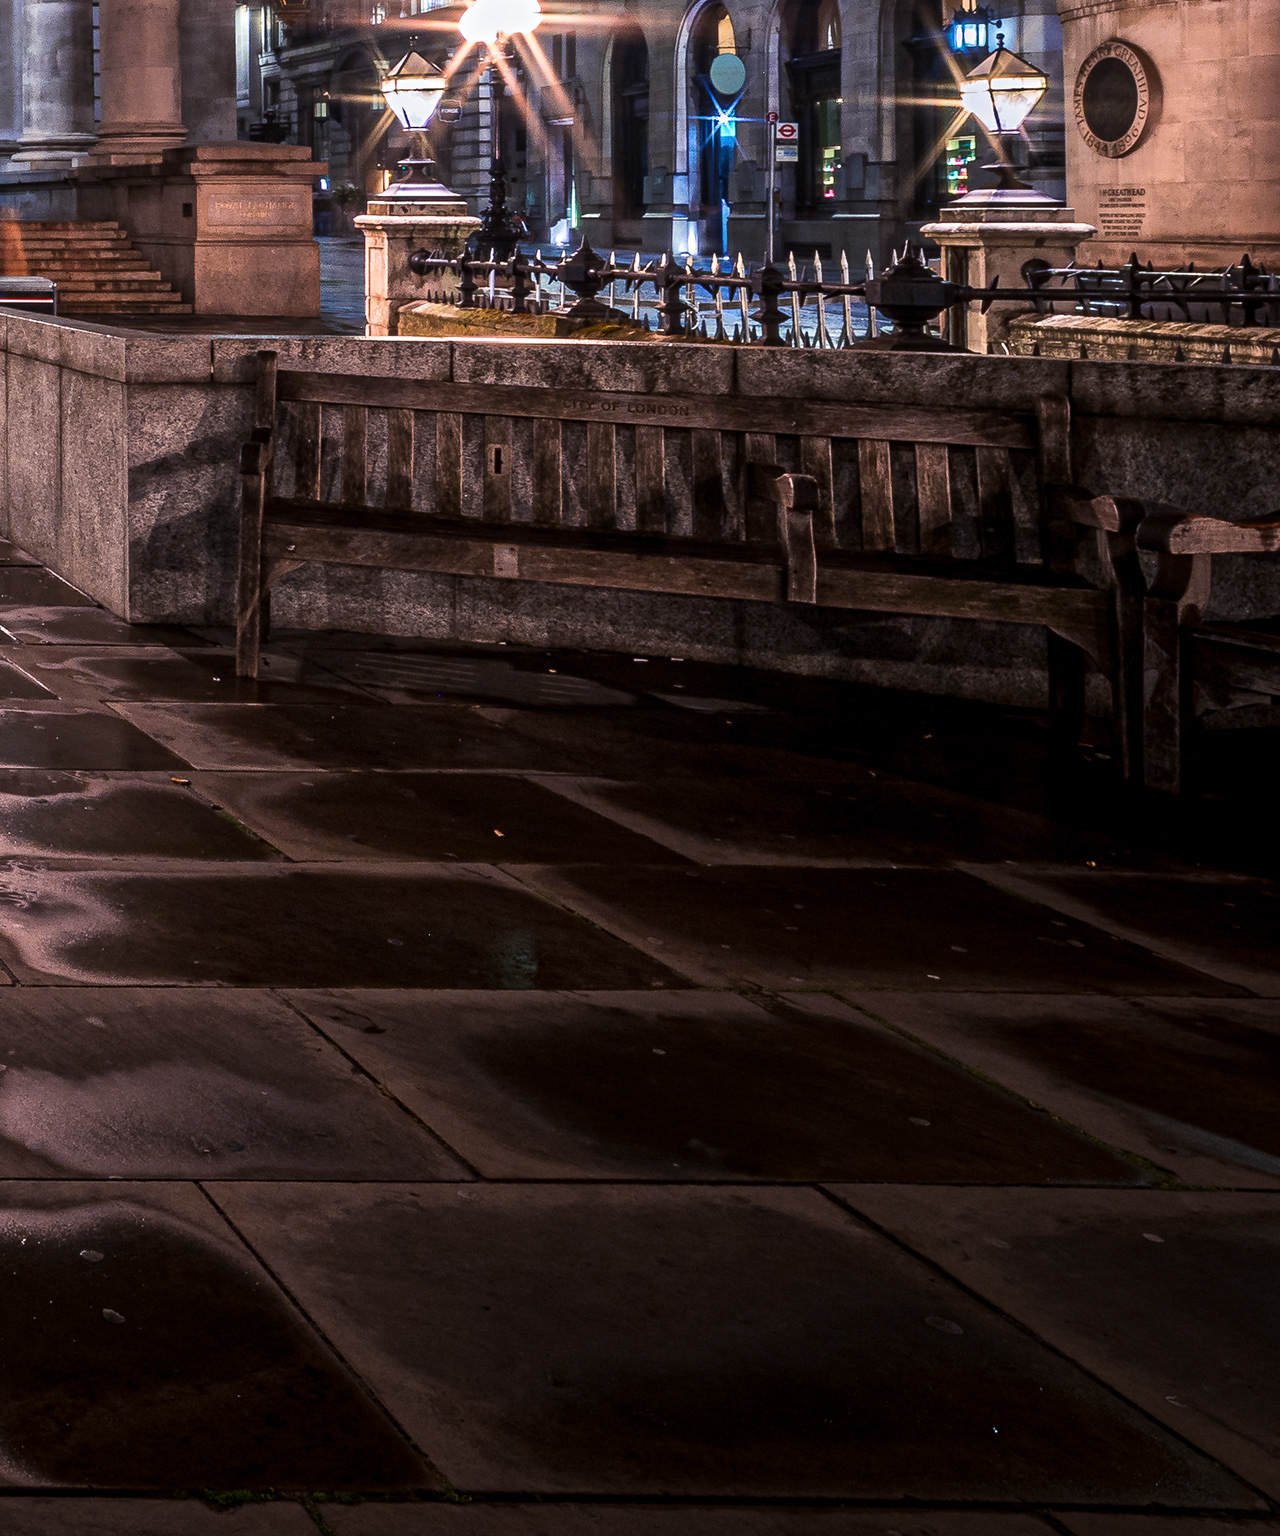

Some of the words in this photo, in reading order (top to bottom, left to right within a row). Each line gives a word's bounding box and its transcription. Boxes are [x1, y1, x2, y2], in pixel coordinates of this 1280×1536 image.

[1073, 80, 1084, 126] JAMES
[1113, 44, 1148, 120] GREATHEAD
[769, 113, 776, 122] E
[561, 398, 595, 410] CITY
[600, 401, 621, 412] OF
[626, 403, 690, 417] LONDON
